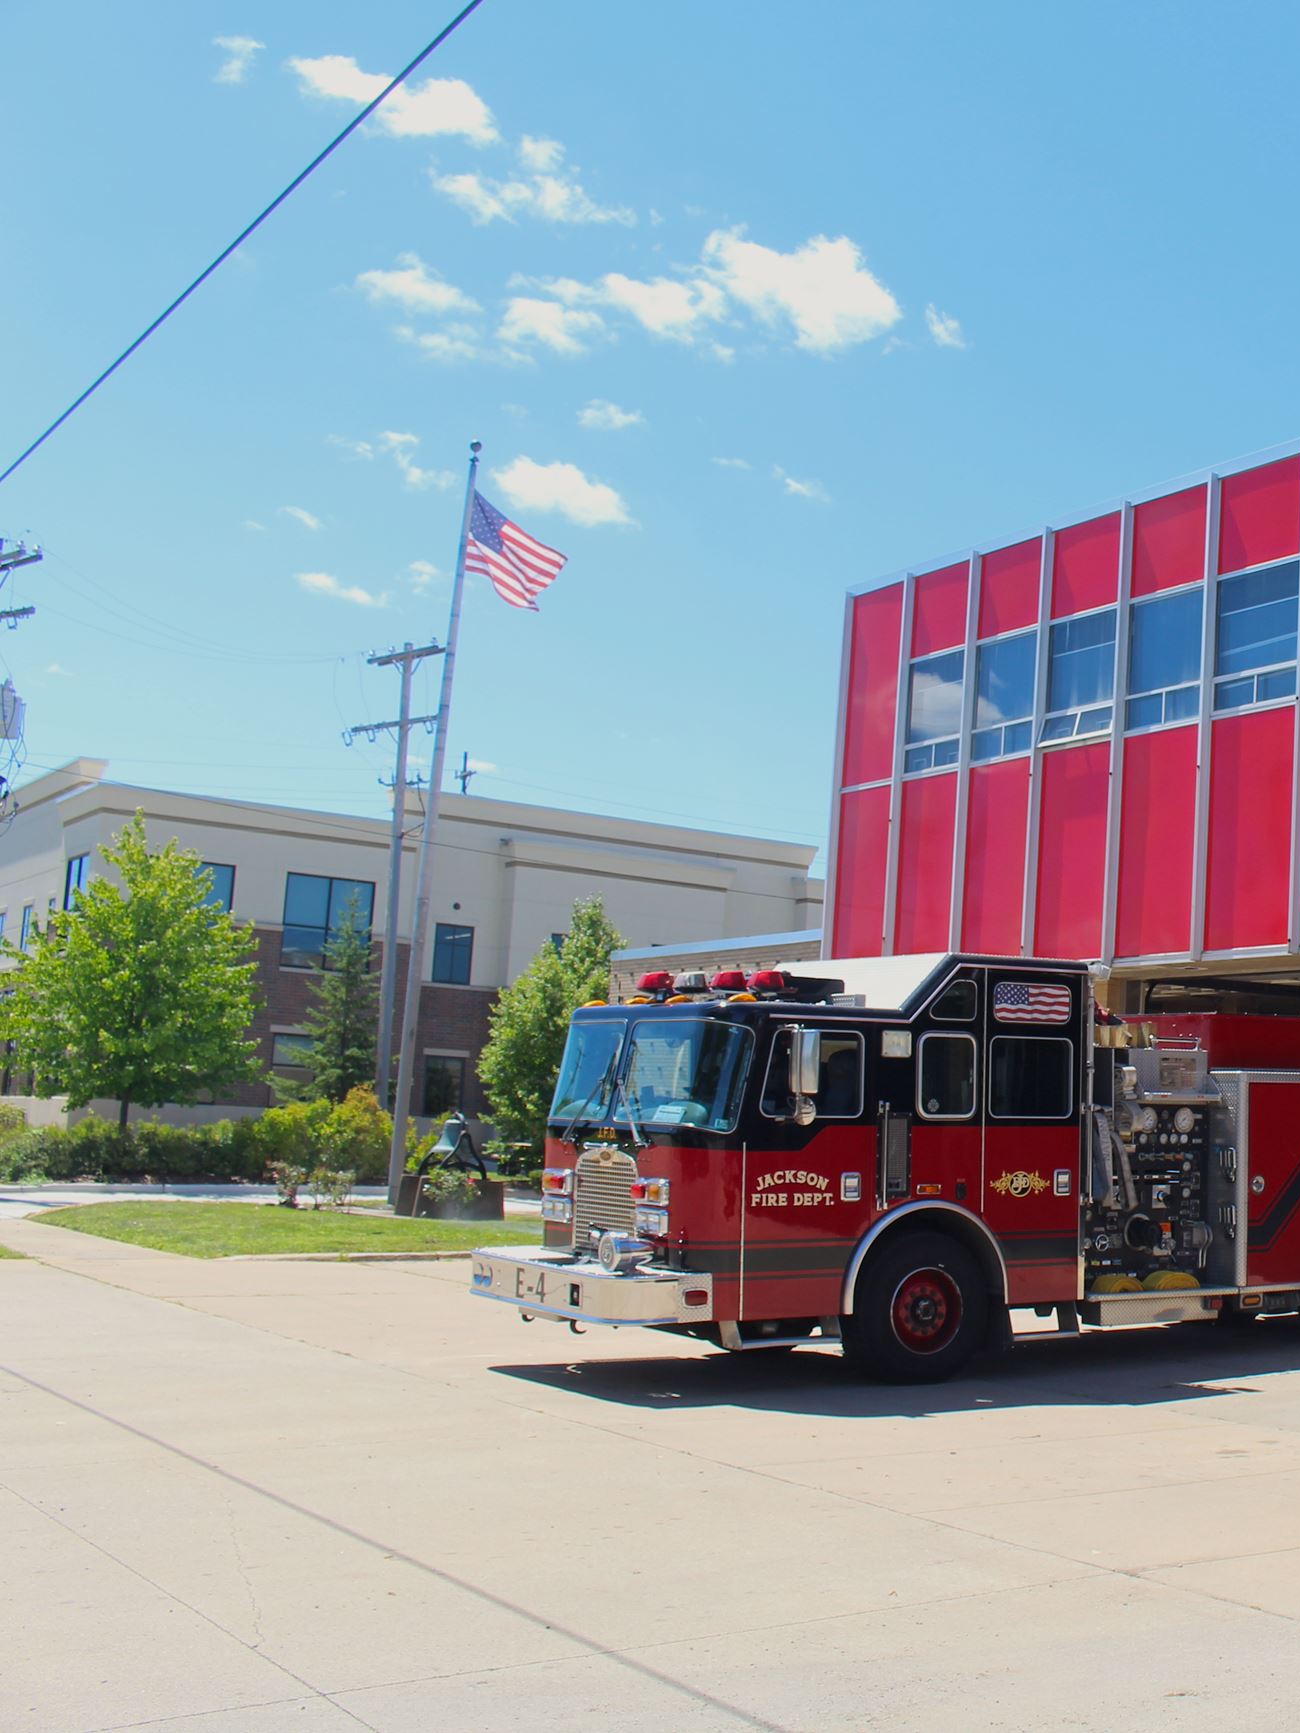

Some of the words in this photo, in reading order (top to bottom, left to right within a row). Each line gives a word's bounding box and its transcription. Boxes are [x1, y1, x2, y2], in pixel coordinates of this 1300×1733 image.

[756, 1170, 829, 1191] JACKSON
[751, 1193, 788, 1207] FIRE
[793, 1193, 835, 1206] DEPT.
[515, 1267, 546, 1303] E-4
